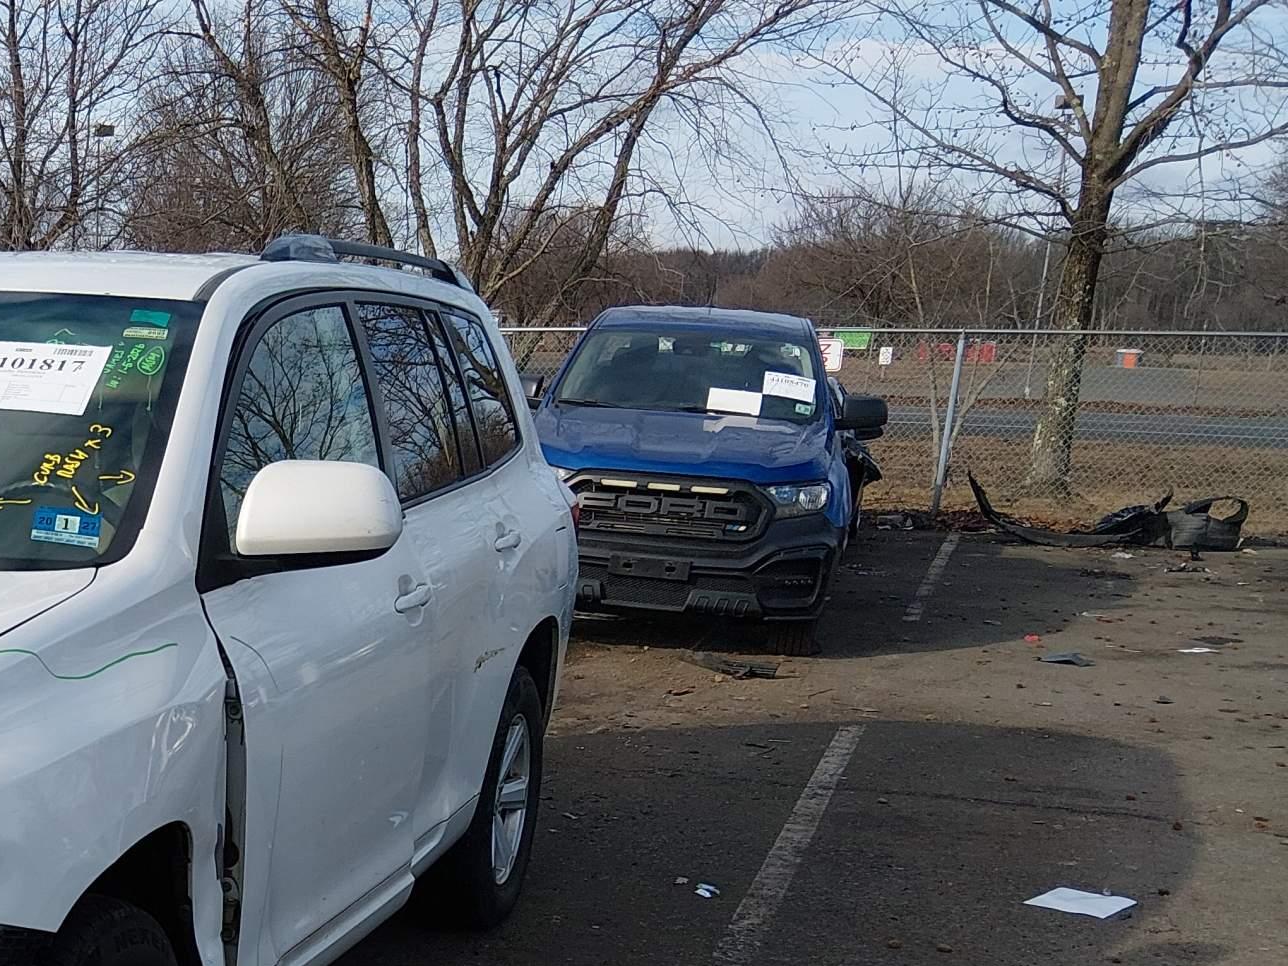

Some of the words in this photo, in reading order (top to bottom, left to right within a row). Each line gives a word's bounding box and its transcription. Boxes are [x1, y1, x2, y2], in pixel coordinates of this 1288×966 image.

[90, 424, 112, 438] 3
[38, 516, 53, 526] 20
[61, 518, 69, 531] 1
[81, 521, 97, 531] 27
